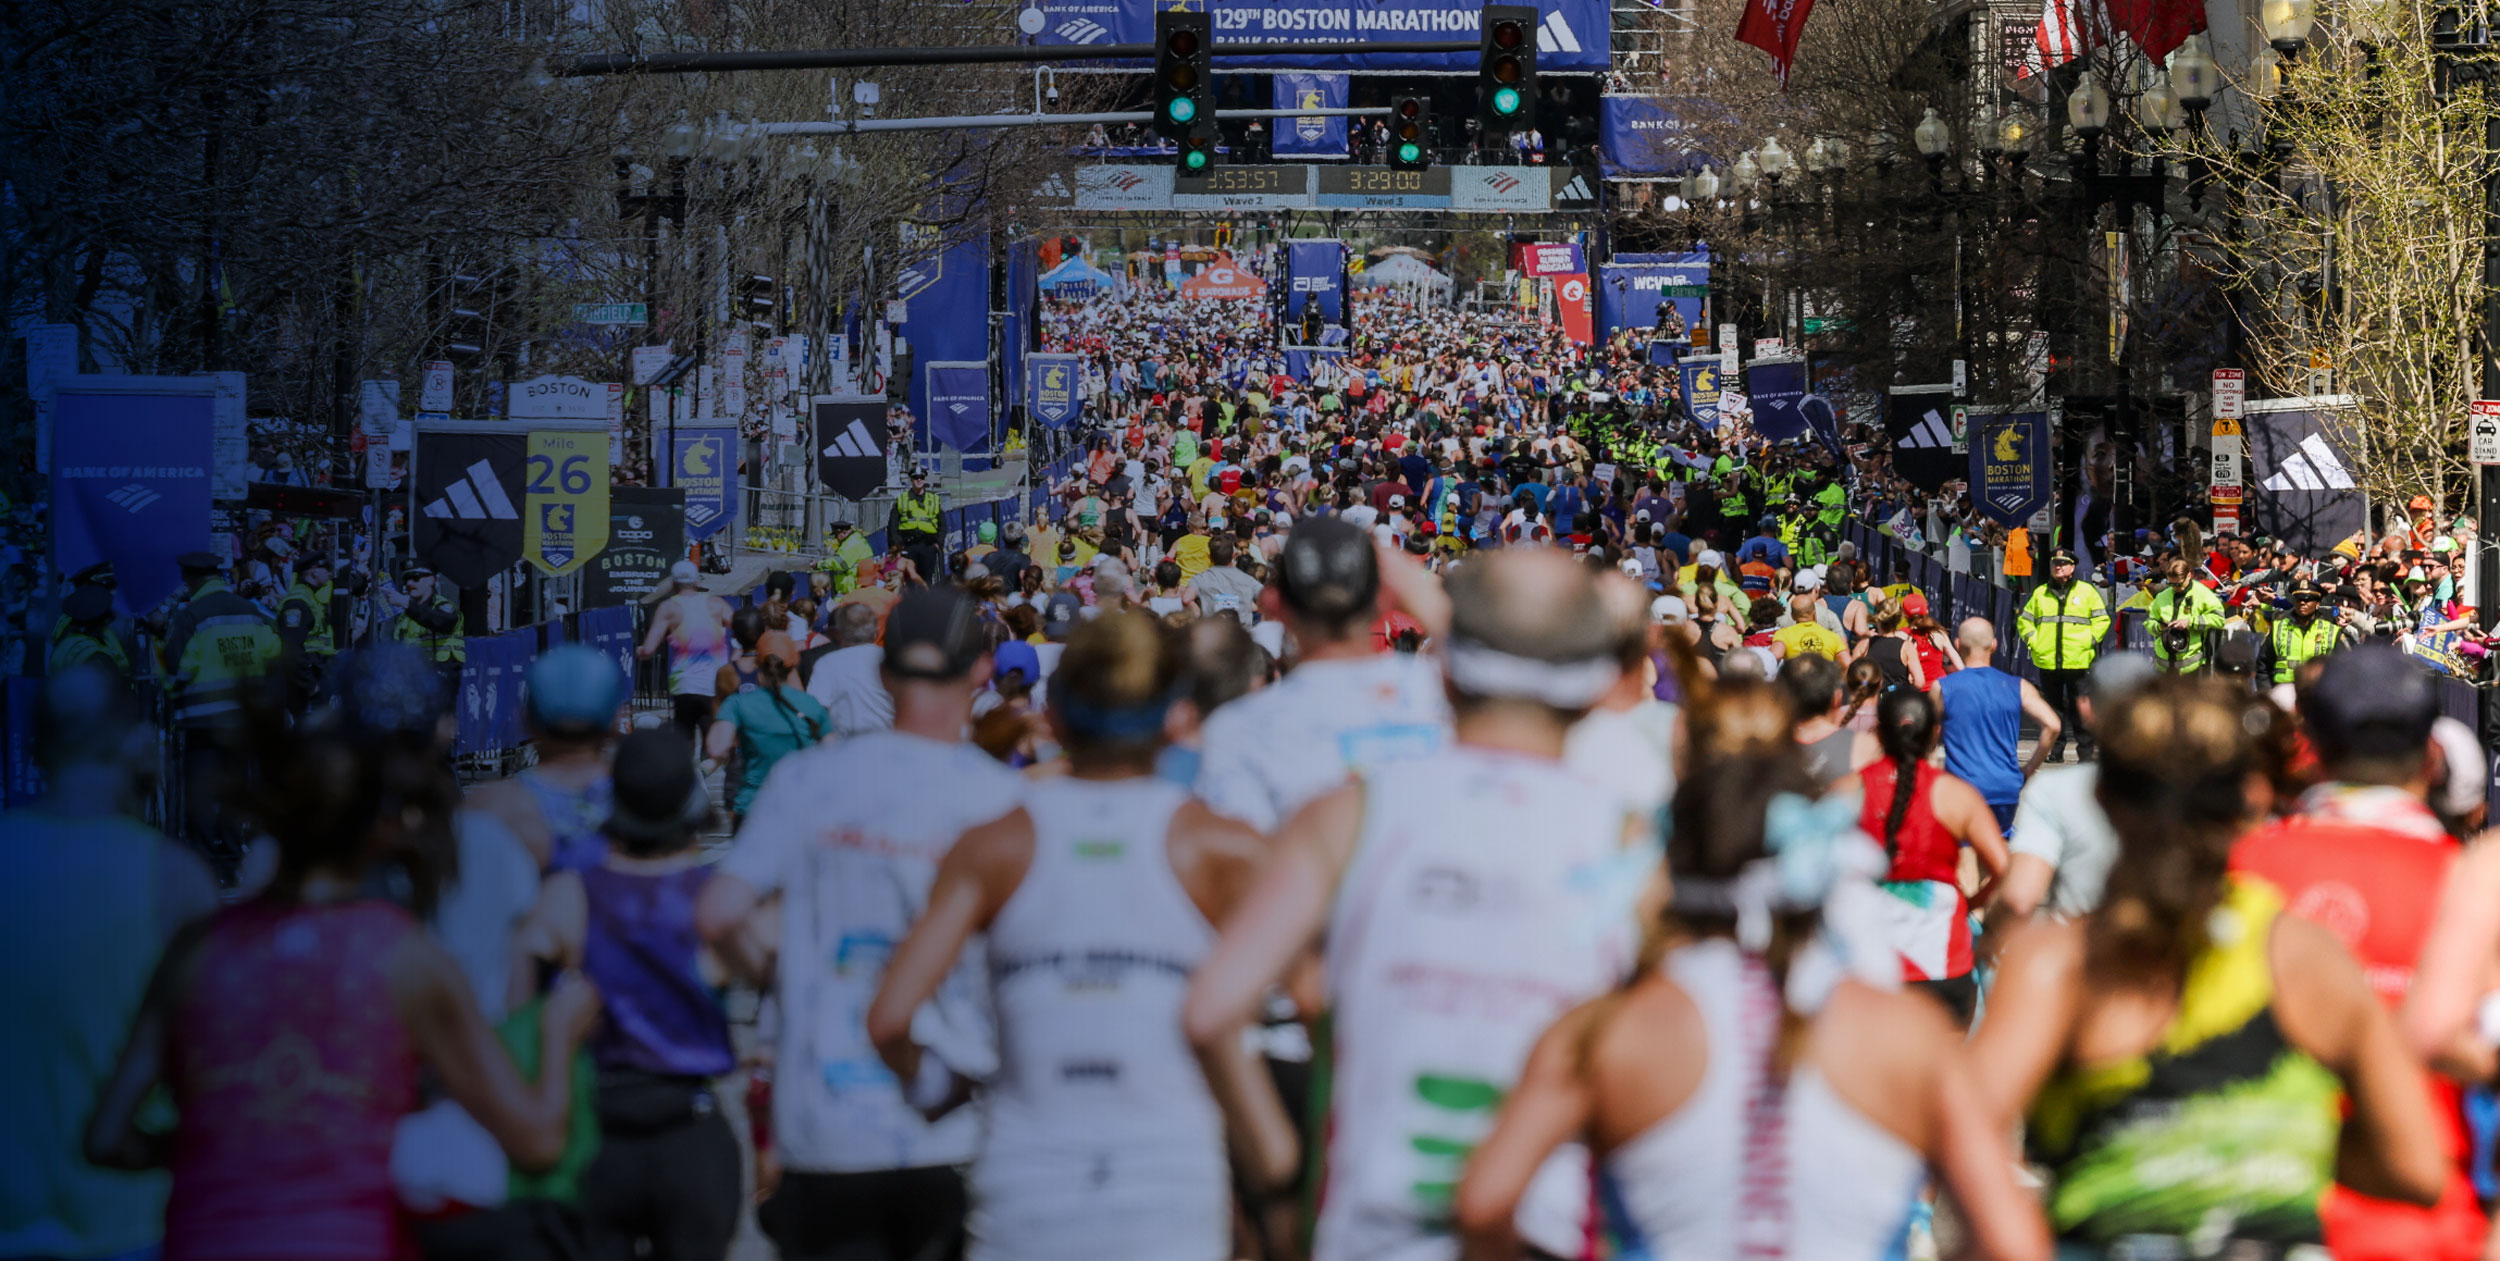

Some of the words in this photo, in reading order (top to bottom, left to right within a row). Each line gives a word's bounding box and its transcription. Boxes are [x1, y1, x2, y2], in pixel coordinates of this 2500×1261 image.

[1043, 5, 1067, 14] BANK
[1068, 5, 1080, 14] OF
[1081, 5, 1120, 14] AMERICA
[1263, 8, 1350, 31] BOSTON
[1356, 8, 1479, 32] MARATHON
[1631, 120, 1663, 130] BANK
[1351, 171, 1421, 190] 3:29:00
[1223, 196, 1252, 206] Wave
[1254, 196, 1263, 205] 2
[1366, 196, 1394, 207] Wave
[1198, 286, 1254, 297] GATORADE
[528, 383, 591, 398] BOSTON
[2222, 421, 2230, 431] T
[543, 437, 575, 449] Mile
[2474, 447, 2498, 455] STAND
[62, 467, 107, 479] BANK
[131, 466, 206, 479] AMERICA
[527, 454, 592, 494] 26
[1987, 464, 2031, 476] BOSTON
[1987, 475, 2031, 484] MARATHON
[543, 532, 574, 540] BOSTON
[601, 553, 666, 570] BOSTON
